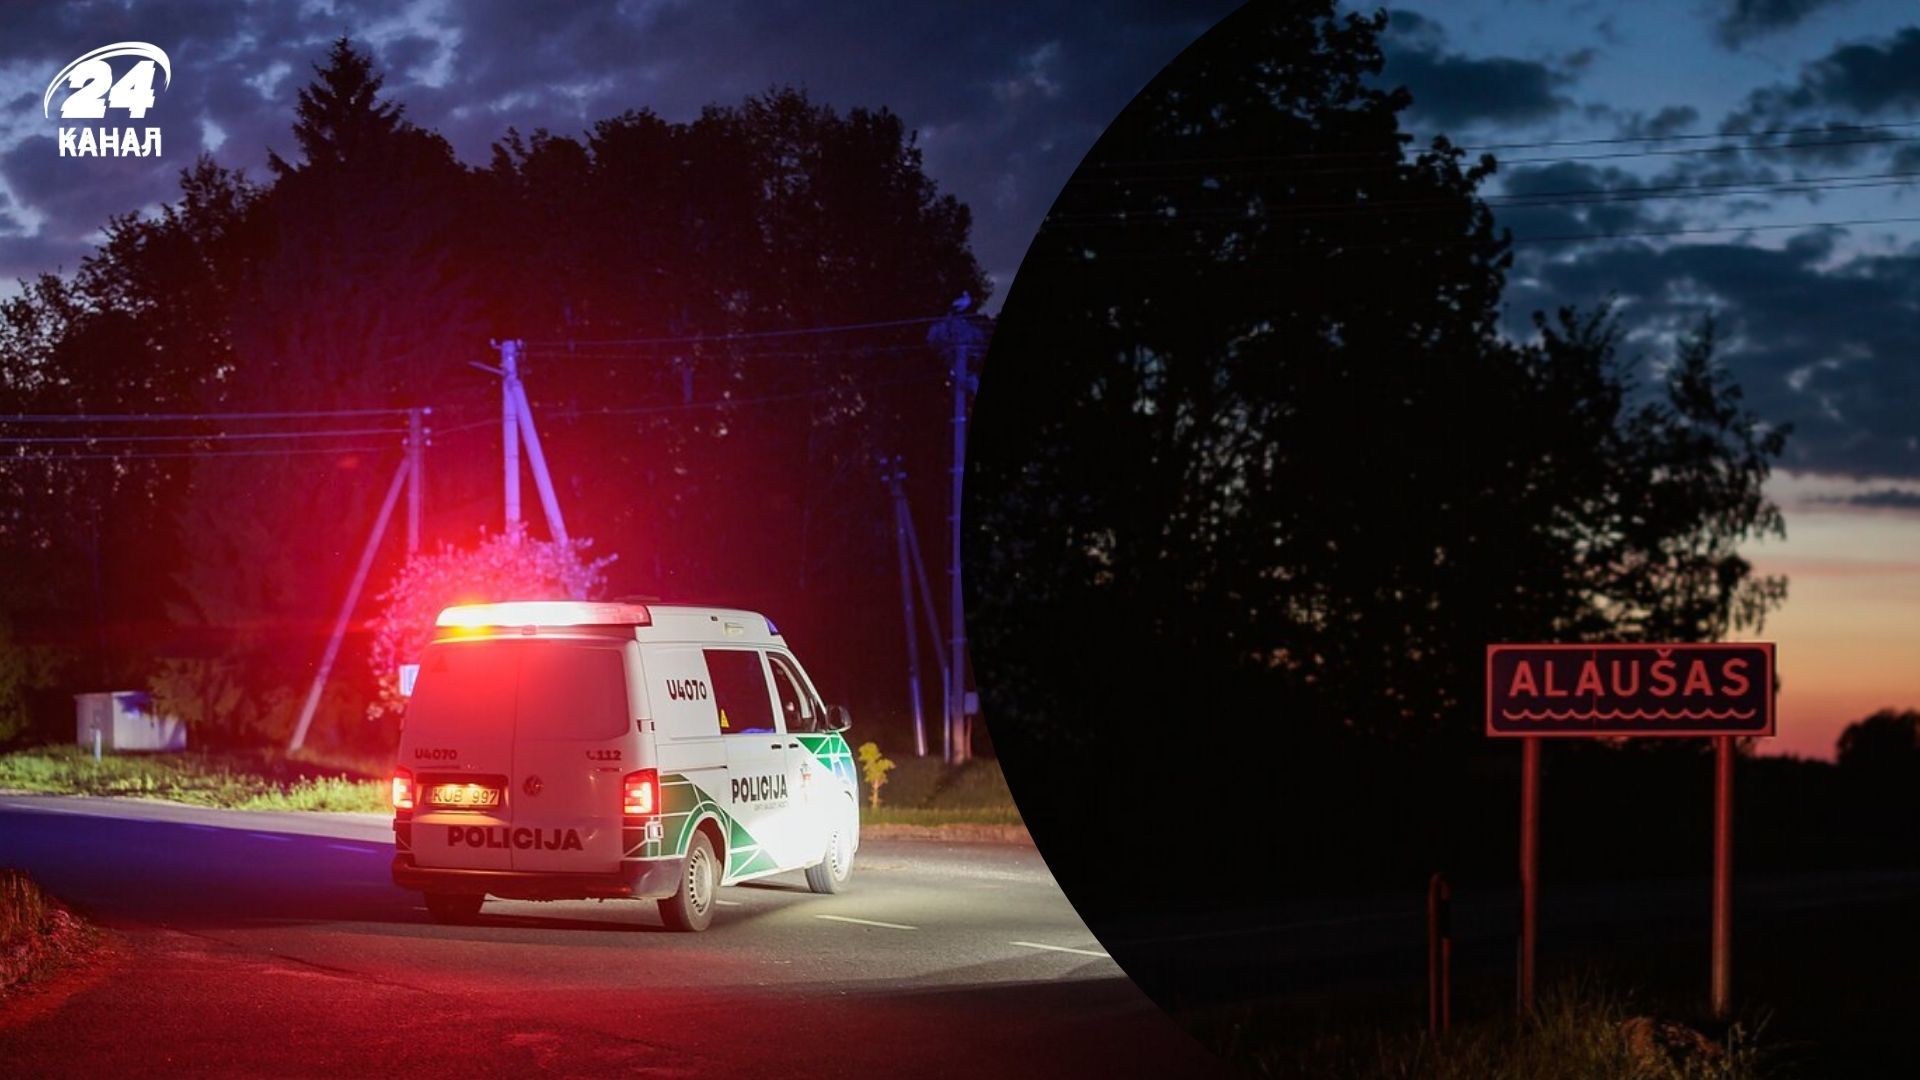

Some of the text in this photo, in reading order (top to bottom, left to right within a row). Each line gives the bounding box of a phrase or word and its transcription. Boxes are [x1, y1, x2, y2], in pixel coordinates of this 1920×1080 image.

[1508, 648, 1750, 697] ALAUŠAS
[666, 679, 707, 701] U4070
[414, 749, 458, 761] U4070
[595, 750, 622, 761] 112
[432, 787, 498, 803] KUB 997
[731, 774, 788, 804] POLICIJA
[447, 826, 584, 852] POLICIJA
